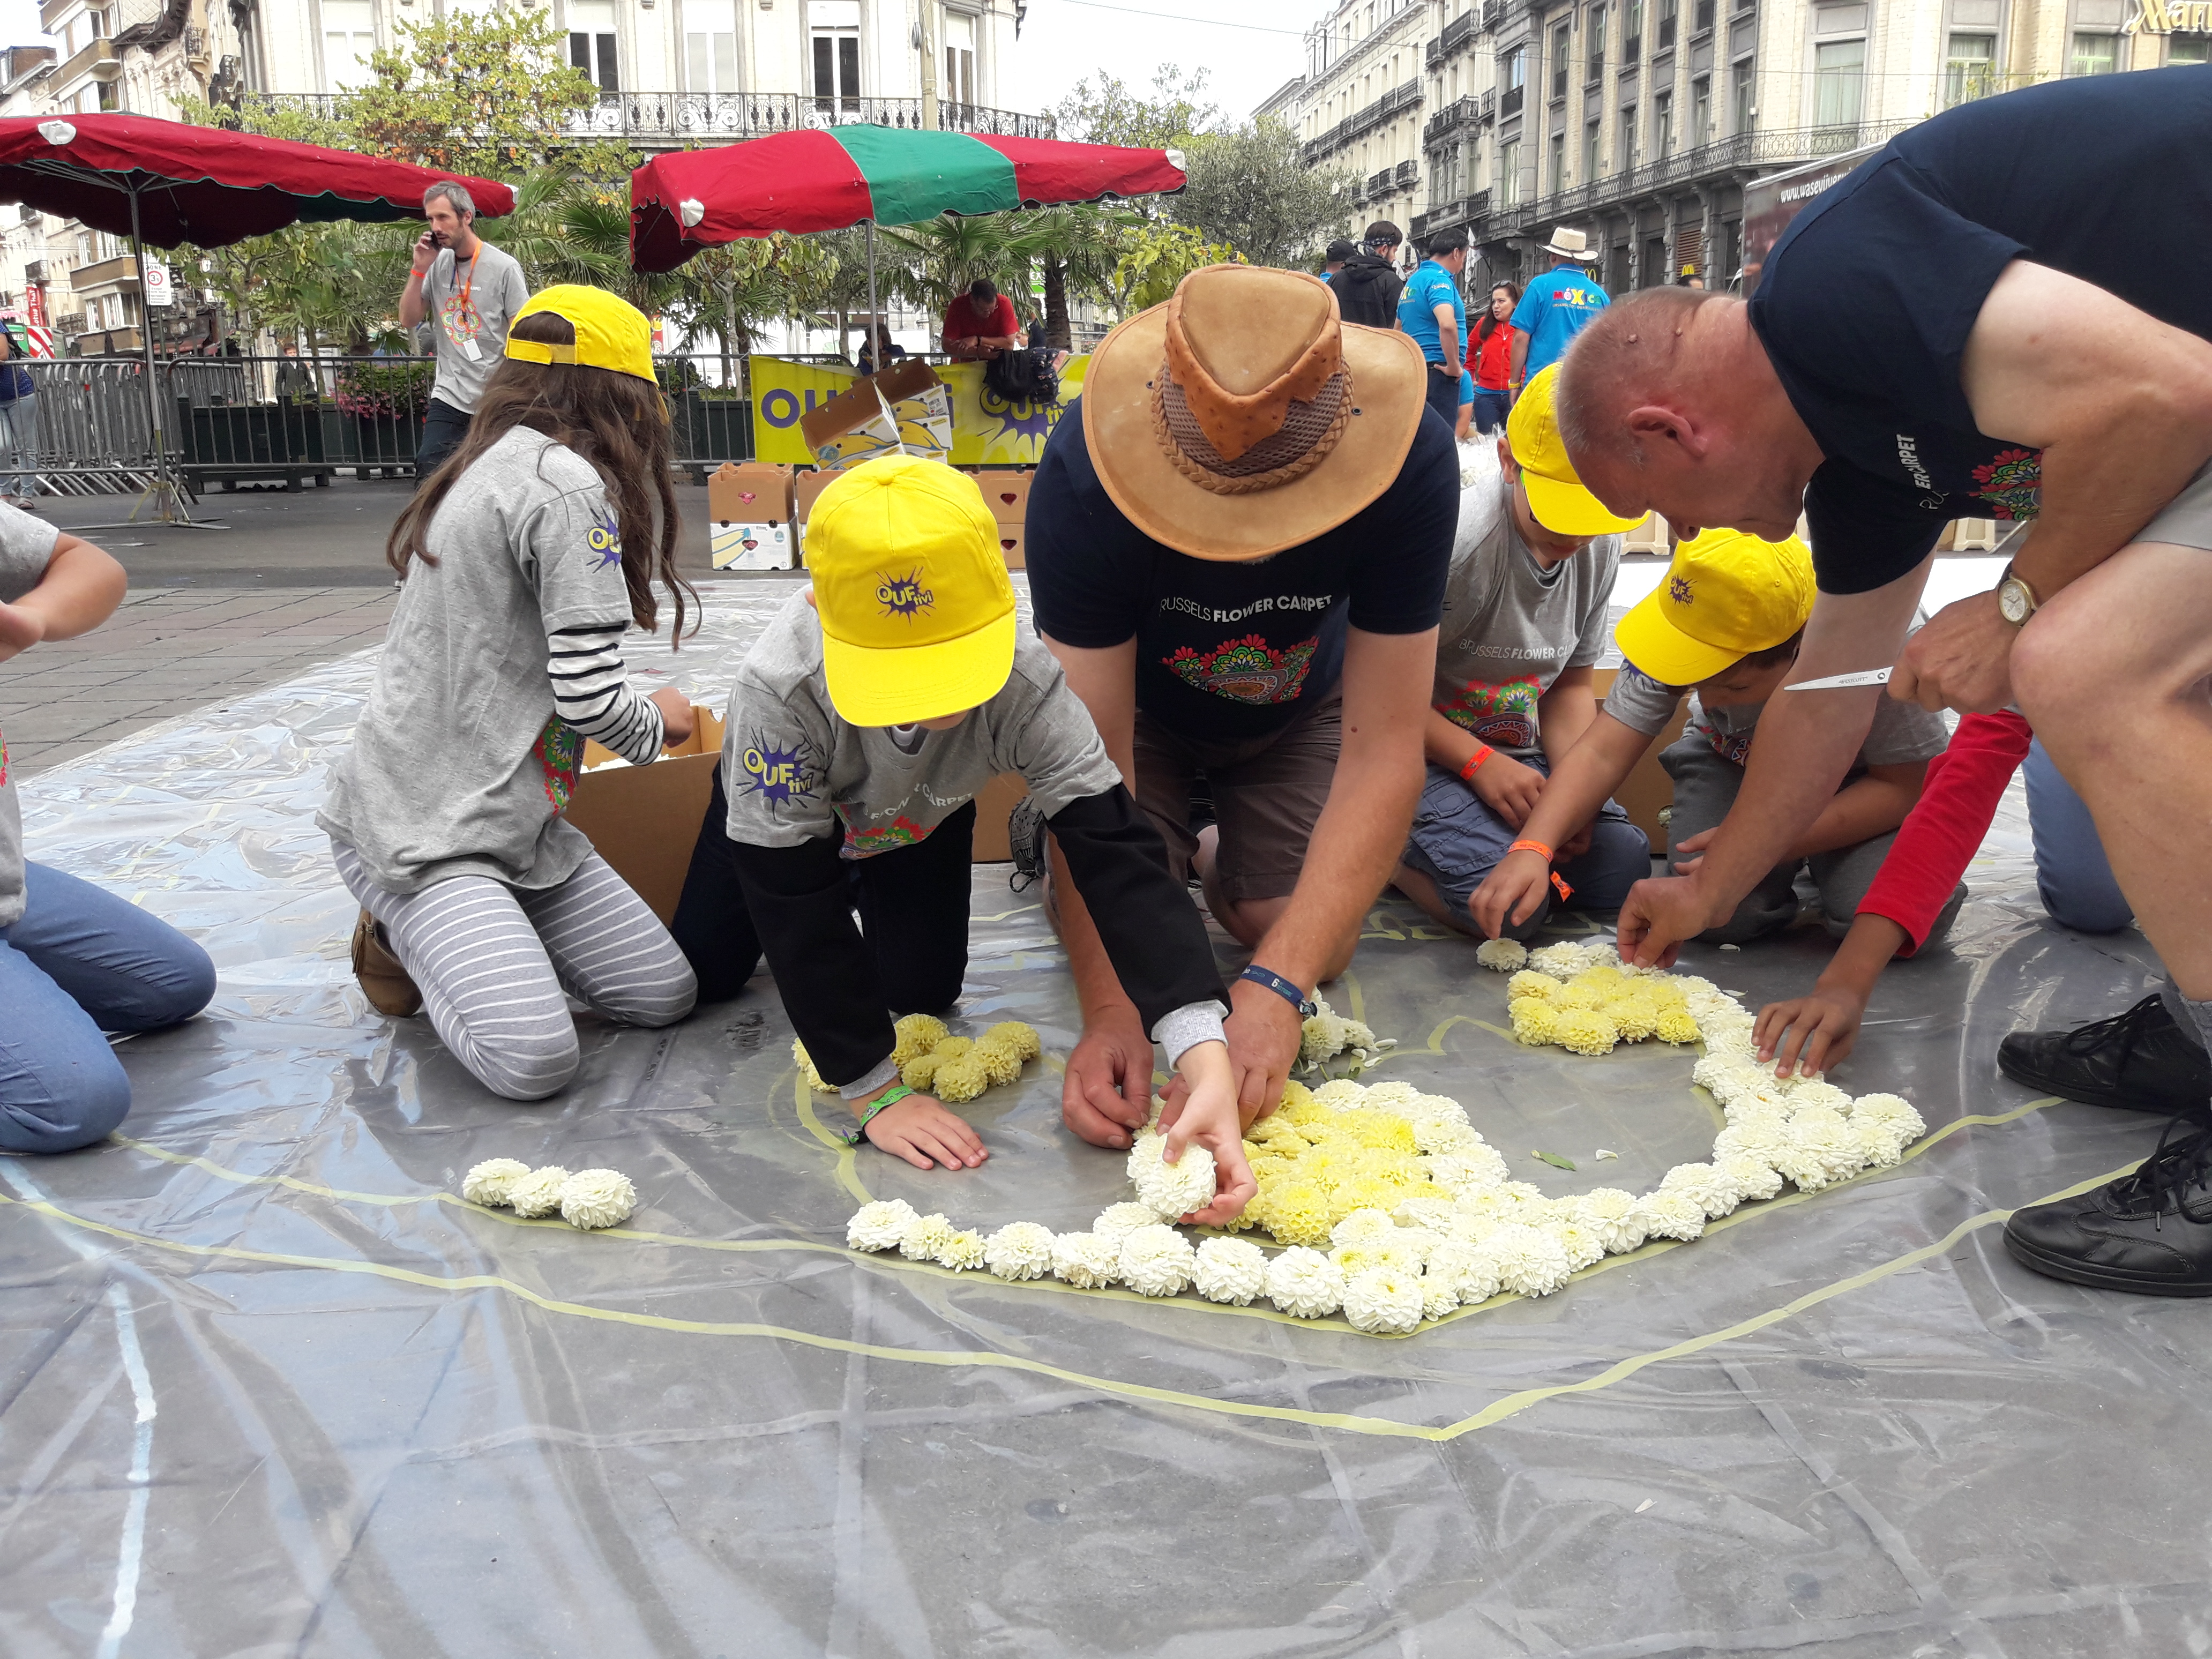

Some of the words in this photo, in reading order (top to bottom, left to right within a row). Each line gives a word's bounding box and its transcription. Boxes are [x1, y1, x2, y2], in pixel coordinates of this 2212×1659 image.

[2121, 0, 2212, 33] Mar
[1213, 597, 1273, 623] FLOWER
[1276, 594, 1332, 611] CARPET
[1459, 638, 1511, 659] BRUSSELS
[1510, 647, 1555, 660] FLOWER
